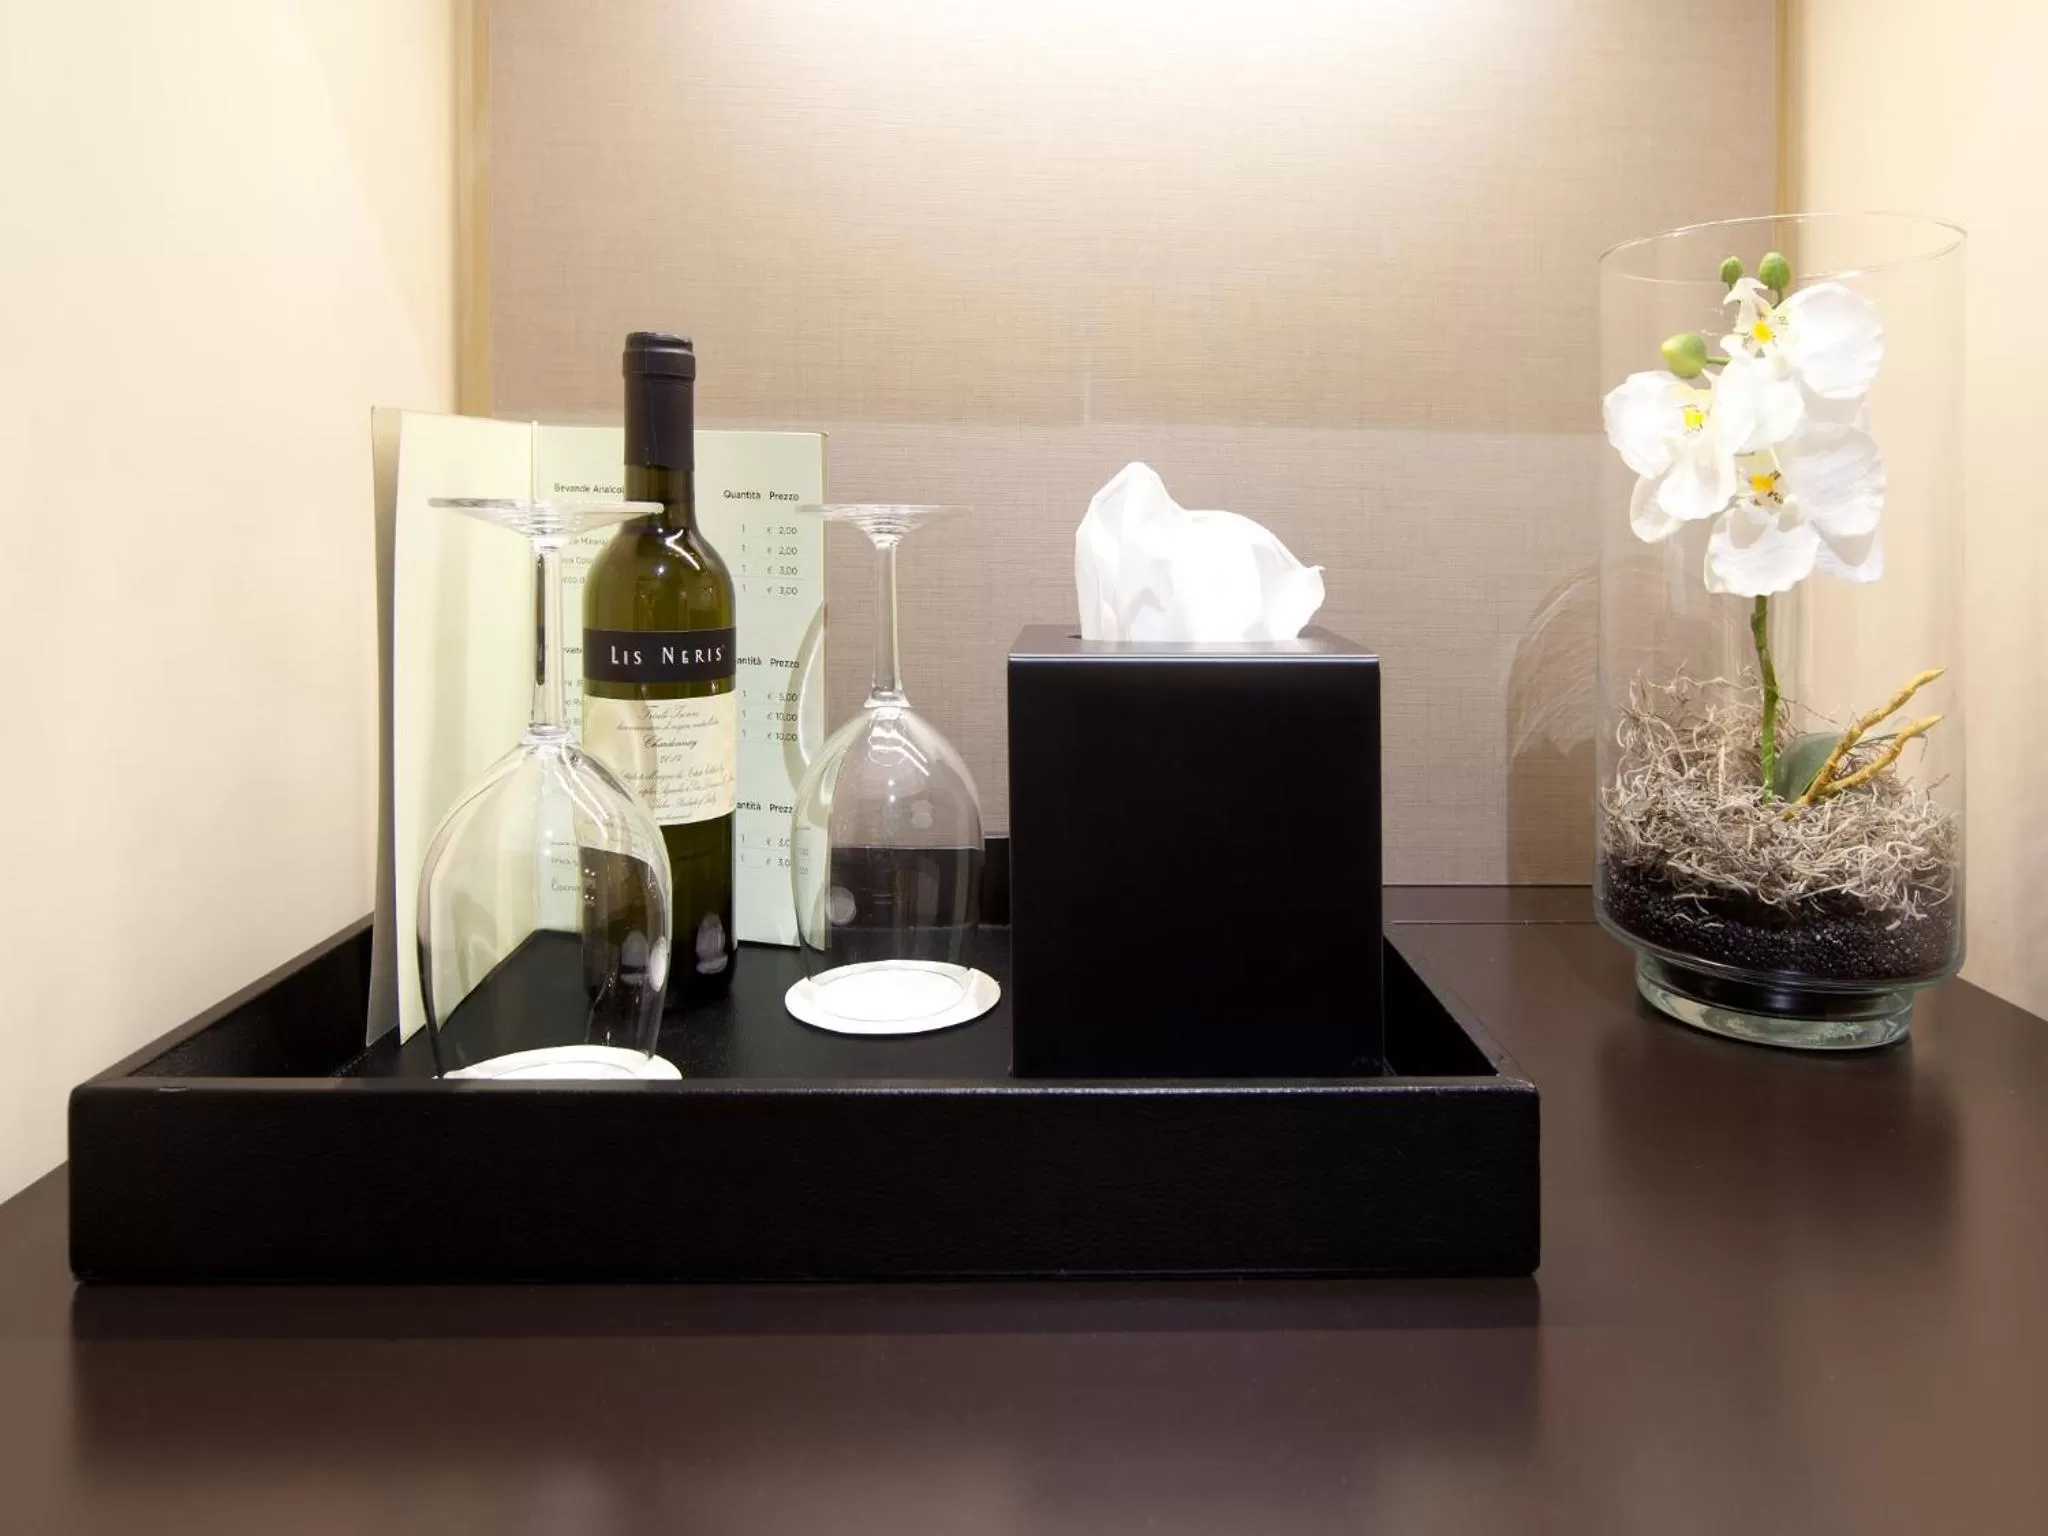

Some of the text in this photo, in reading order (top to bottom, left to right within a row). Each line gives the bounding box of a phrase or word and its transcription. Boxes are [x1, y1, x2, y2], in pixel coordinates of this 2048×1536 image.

[554, 482, 590, 493] Bevande
[769, 491, 800, 502] Prezzo
[736, 656, 800, 669] antità Prezzo
[736, 801, 794, 814] antità Prezz
